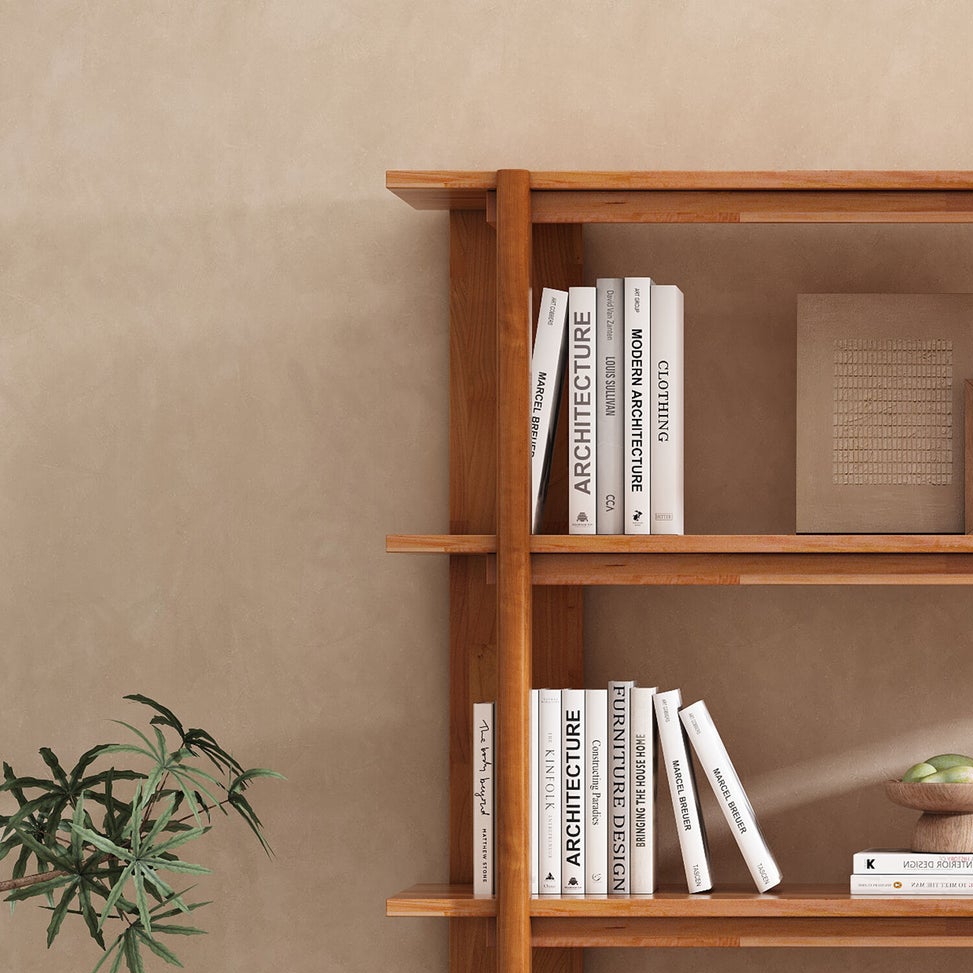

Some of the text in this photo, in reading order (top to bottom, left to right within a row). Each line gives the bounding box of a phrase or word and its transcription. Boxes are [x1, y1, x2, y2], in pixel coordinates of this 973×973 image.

[606, 290, 614, 340] David Van Zanten
[531, 370, 547, 458] MARCEL BREU
[574, 312, 591, 495] ARCHITECTURE
[605, 356, 616, 416] LOUIS SULLIVAN
[631, 328, 643, 492] MODERN ARCHITECTURE
[657, 360, 670, 442] CLOTHING
[479, 720, 490, 743] The
[480, 746, 492, 772] body
[590, 739, 602, 790] Constructing
[545, 749, 555, 810] KINFOLK
[566, 710, 580, 866] ARCHITECTURE
[613, 686, 626, 892] FURNITURE DESIGN
[636, 734, 646, 848] BRINGING THE HOUSE HOME
[672, 760, 692, 832] MARCEL BREUER
[712, 768, 747, 834] MARCEL BREUER
